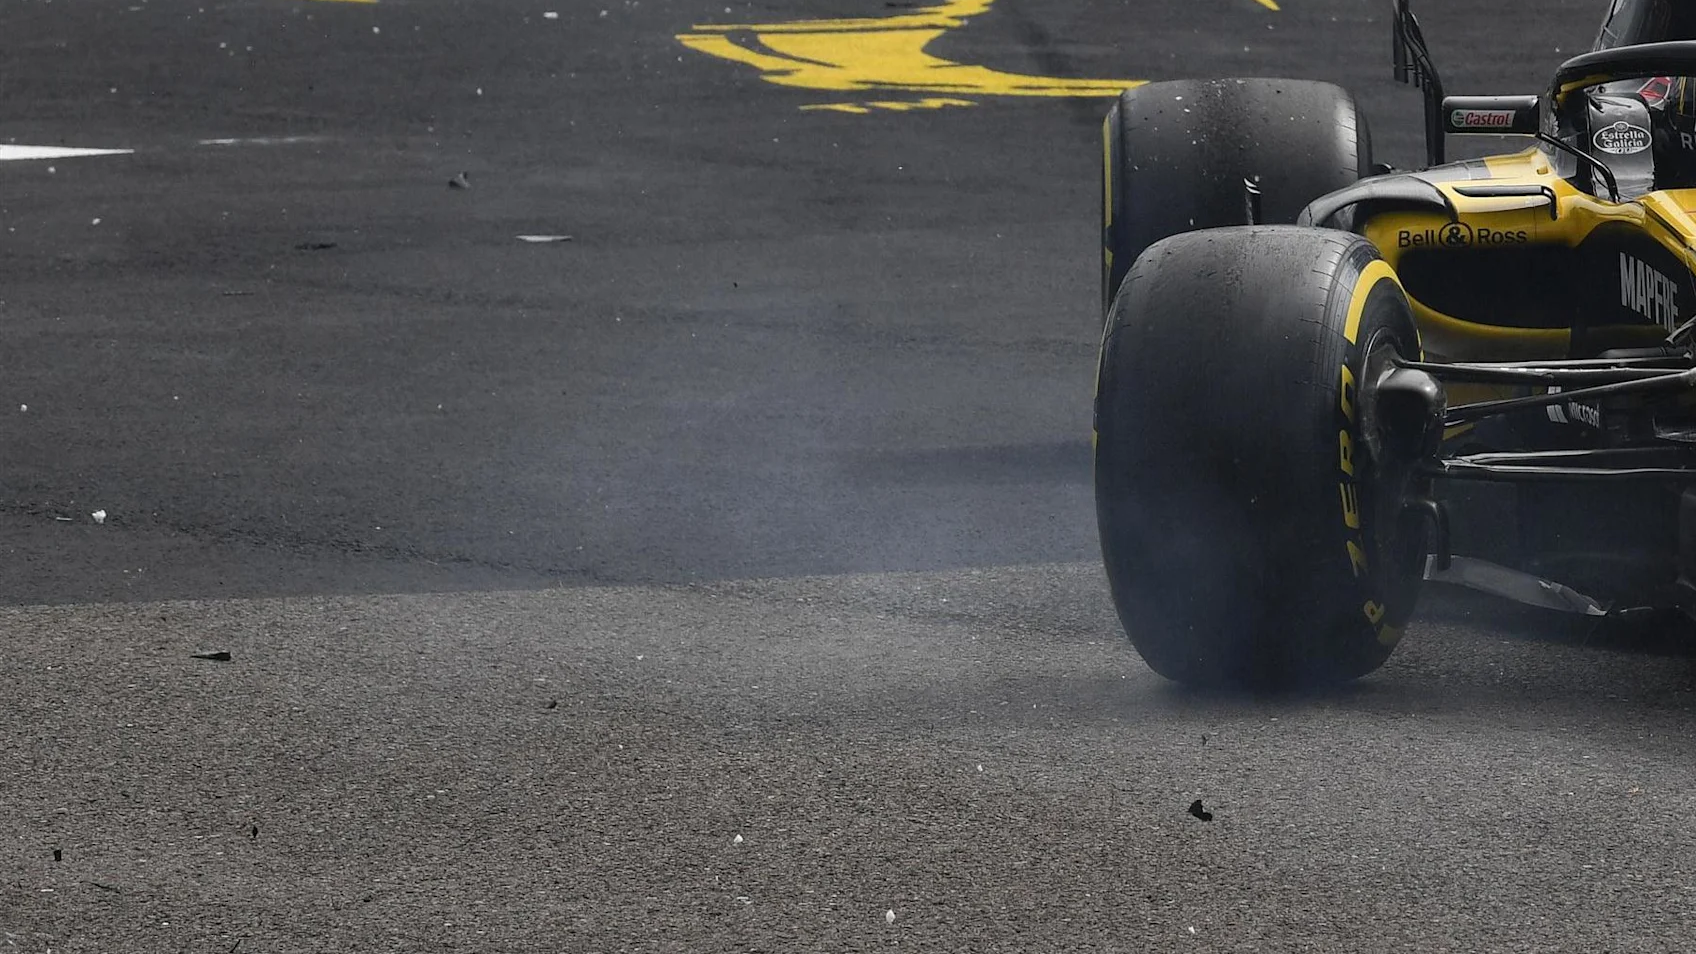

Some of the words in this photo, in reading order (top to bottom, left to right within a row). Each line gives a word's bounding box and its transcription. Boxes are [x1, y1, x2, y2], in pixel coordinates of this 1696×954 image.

[1465, 111, 1512, 127] Castrol
[1601, 130, 1645, 140] Estrella
[1603, 138, 1644, 148] Galicia
[1398, 229, 1435, 248] Bell
[1443, 224, 1469, 246] &
[1477, 228, 1528, 245] Ross
[1619, 251, 1679, 334] MAPFRE
